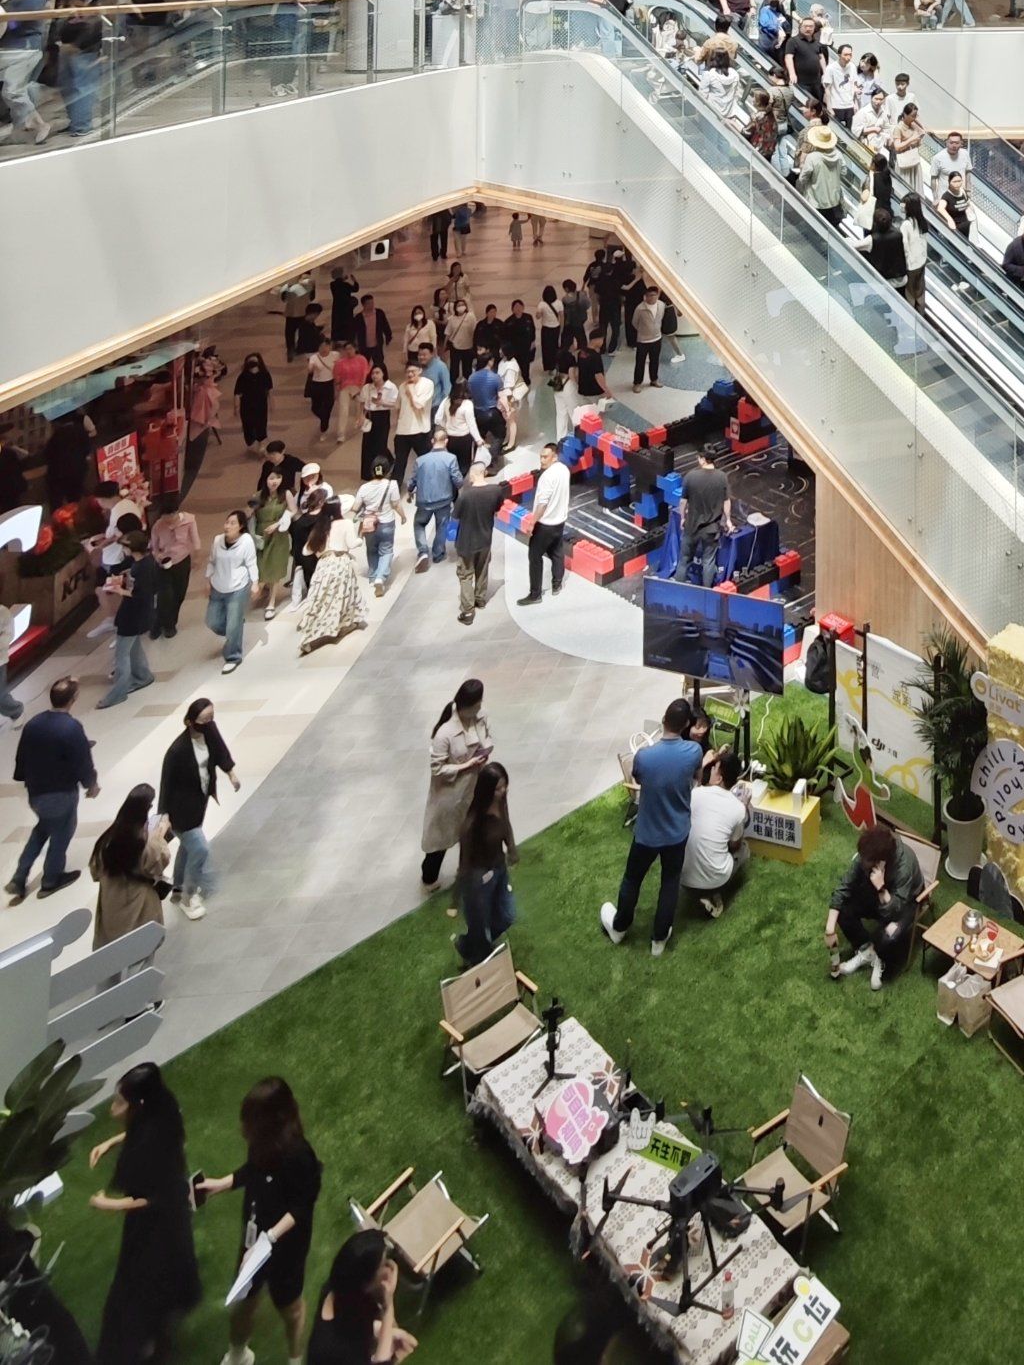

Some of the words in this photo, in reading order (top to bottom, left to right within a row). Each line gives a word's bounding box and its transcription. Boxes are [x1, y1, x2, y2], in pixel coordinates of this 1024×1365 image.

[988, 687, 1022, 714] Livat
[978, 747, 1005, 788] chill
[753, 811, 796, 831] 阳光很暖
